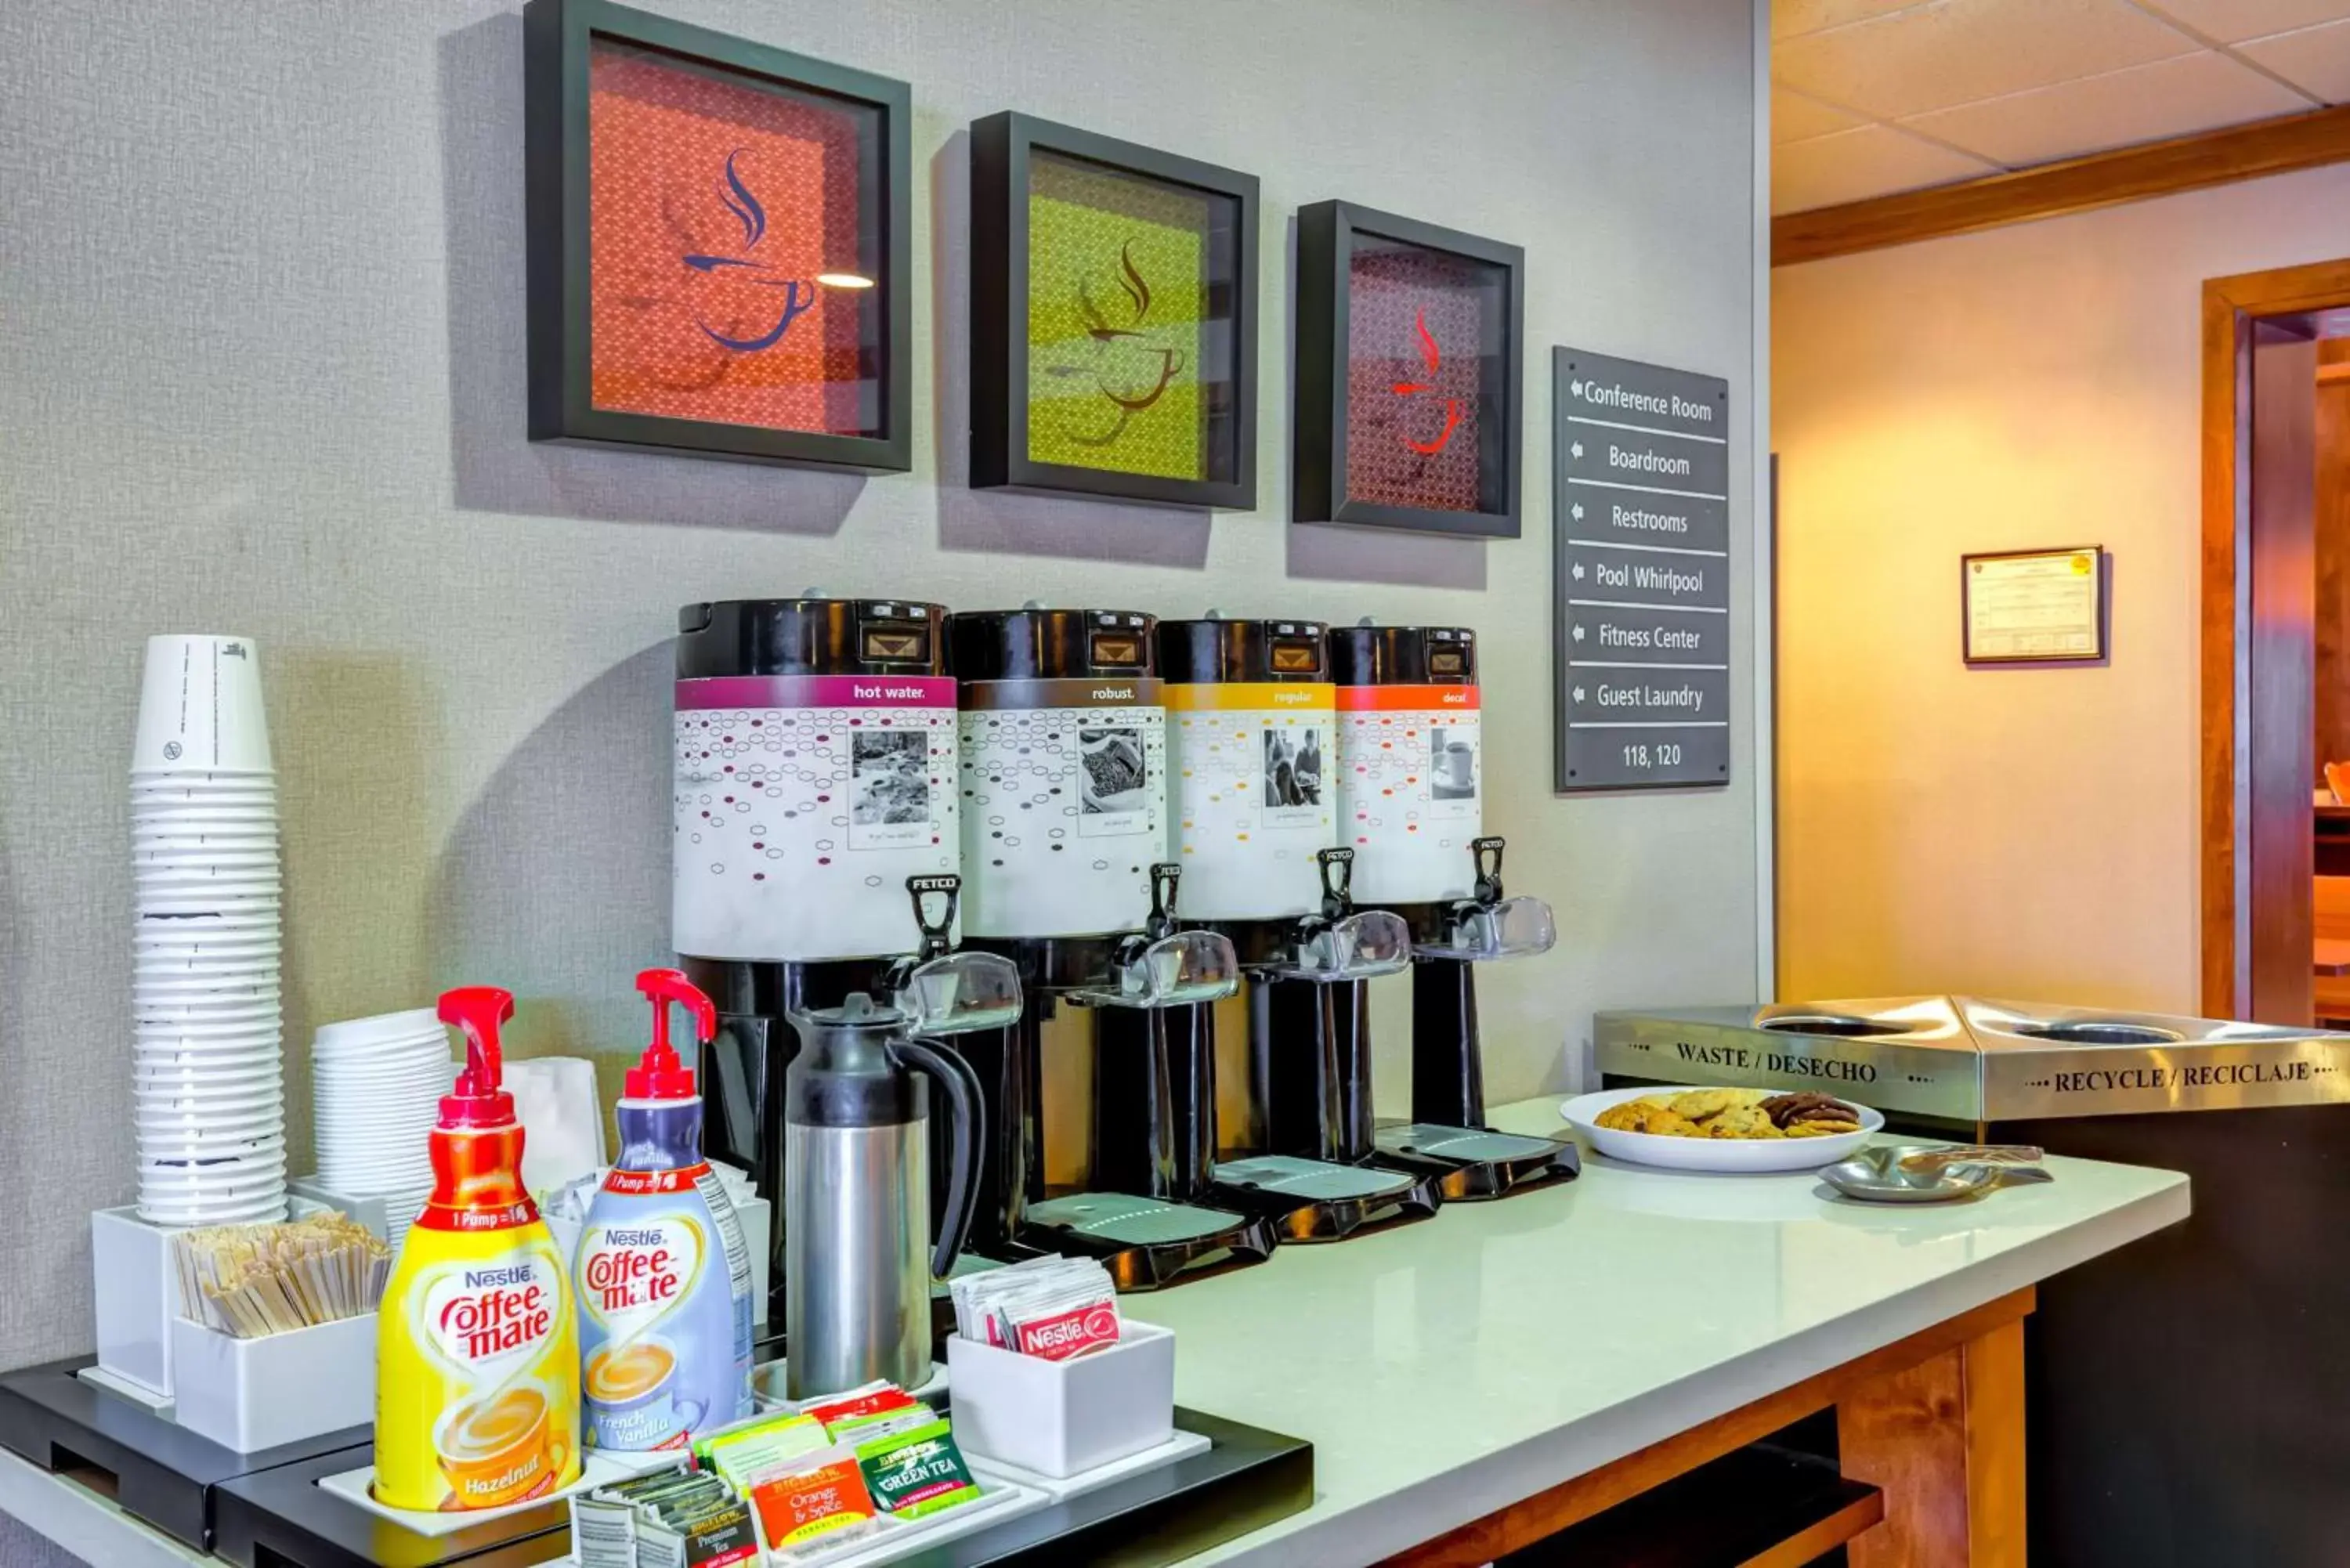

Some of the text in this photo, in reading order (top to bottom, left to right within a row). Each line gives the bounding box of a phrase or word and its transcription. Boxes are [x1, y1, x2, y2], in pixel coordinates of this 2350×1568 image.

[1585, 381, 1712, 421] Conference Room
[1609, 445, 1690, 475] Boardroom
[1612, 505, 1688, 533] Restrooms
[1596, 563, 1703, 595] Pool Whirlpool
[1600, 623, 1701, 649] Fitness Center
[854, 684, 926, 699] hot water.
[1597, 684, 1703, 710] Guest Laundry
[1623, 745, 1681, 770] 118, 120
[913, 878, 956, 890] FETCO
[1676, 1042, 1877, 1084] WASTE / DESECHO
[2055, 1061, 2309, 1093] RECYCLE / RECICLAJE
[454, 1212, 459, 1227] 1
[461, 1212, 497, 1228] Pump
[469, 1310, 549, 1359] mate
[599, 1411, 645, 1429] French
[616, 1418, 670, 1443] Vanilla
[465, 1453, 540, 1495] Hazelnut
[878, 1458, 958, 1492] GREEN TEA
[789, 1487, 839, 1508] Orange
[794, 1499, 845, 1523] & Spice
[697, 1526, 739, 1548] Premium
[712, 1541, 729, 1555] Tea
